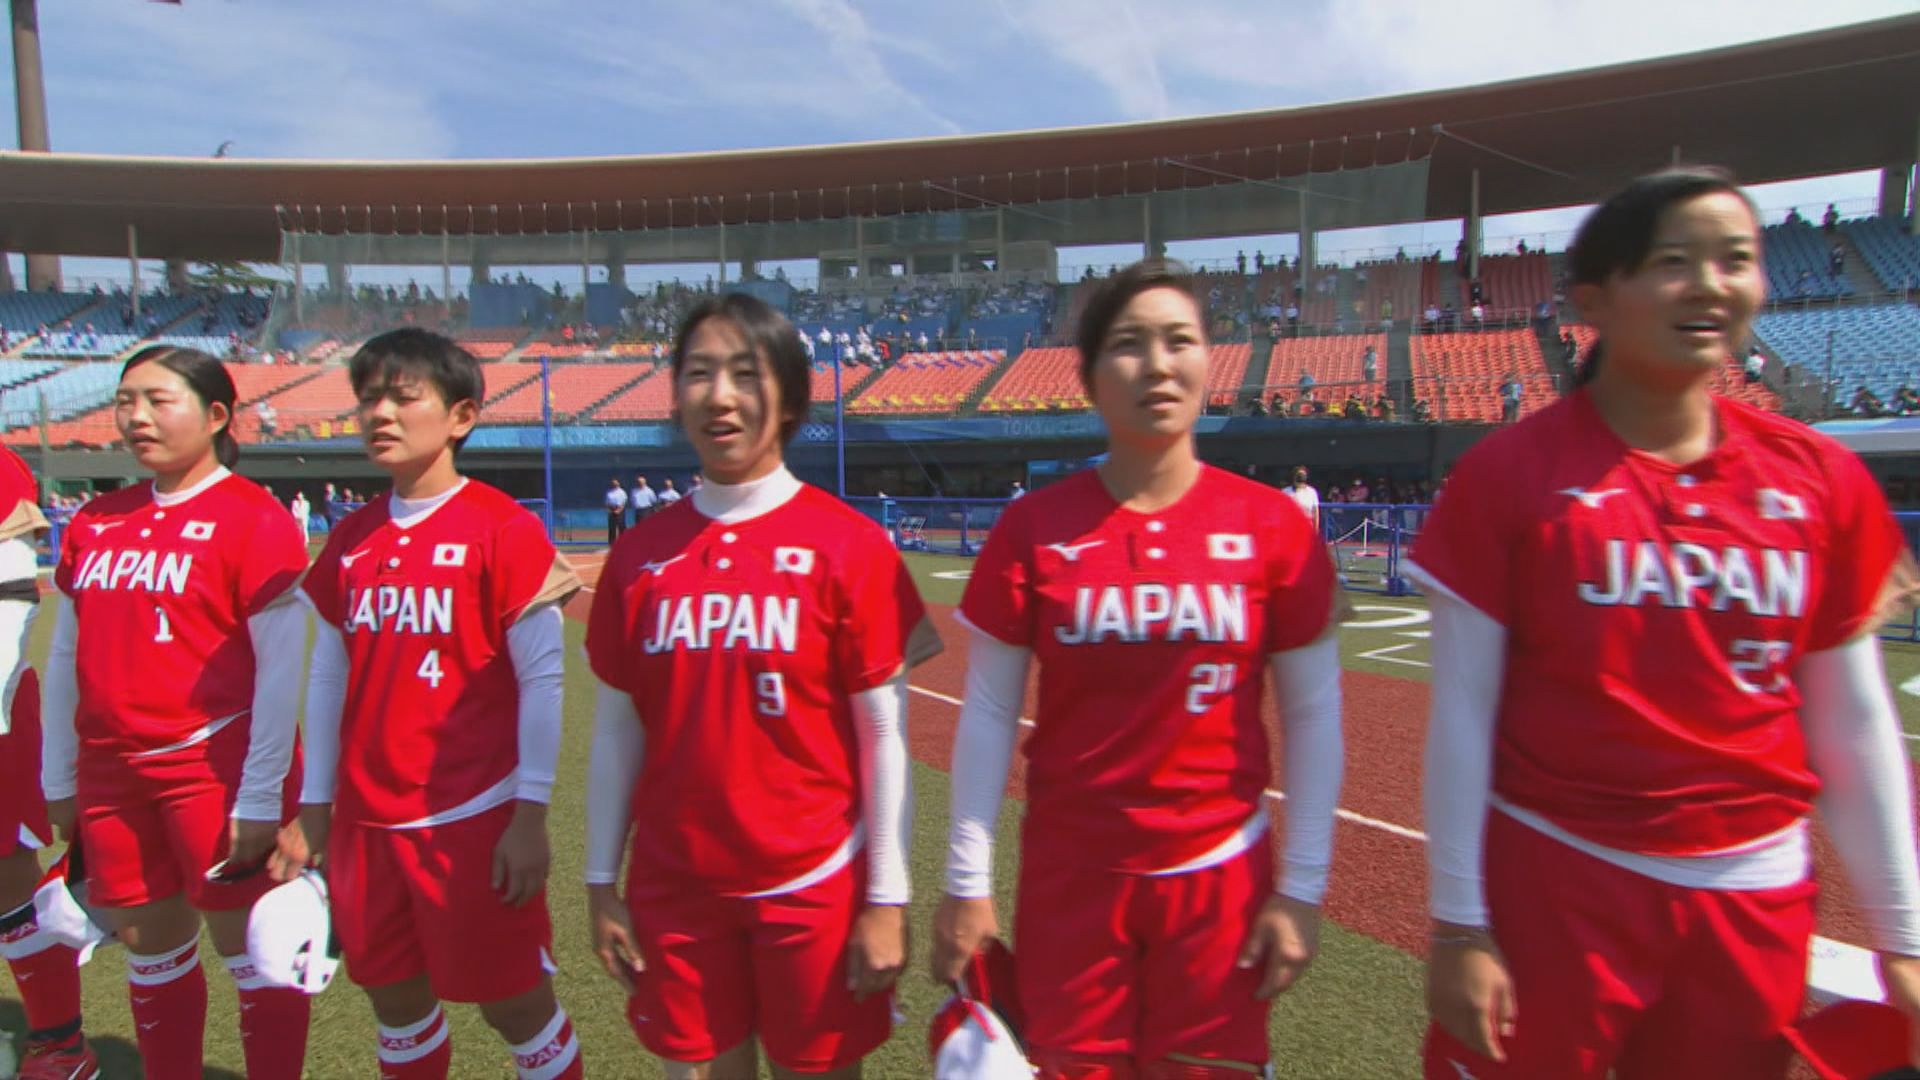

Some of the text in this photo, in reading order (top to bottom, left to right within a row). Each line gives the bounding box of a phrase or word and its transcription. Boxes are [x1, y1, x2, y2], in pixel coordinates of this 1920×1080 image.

[549, 427, 597, 446] OKYO
[73, 549, 193, 595] JAPAN
[1578, 540, 1808, 618] JAPAN
[154, 606, 174, 642] 1
[344, 585, 453, 634] JAPAN
[644, 592, 801, 654] JAPAN
[1053, 583, 1247, 644] JAPAN
[416, 649, 445, 689] 4
[756, 671, 786, 718] 9
